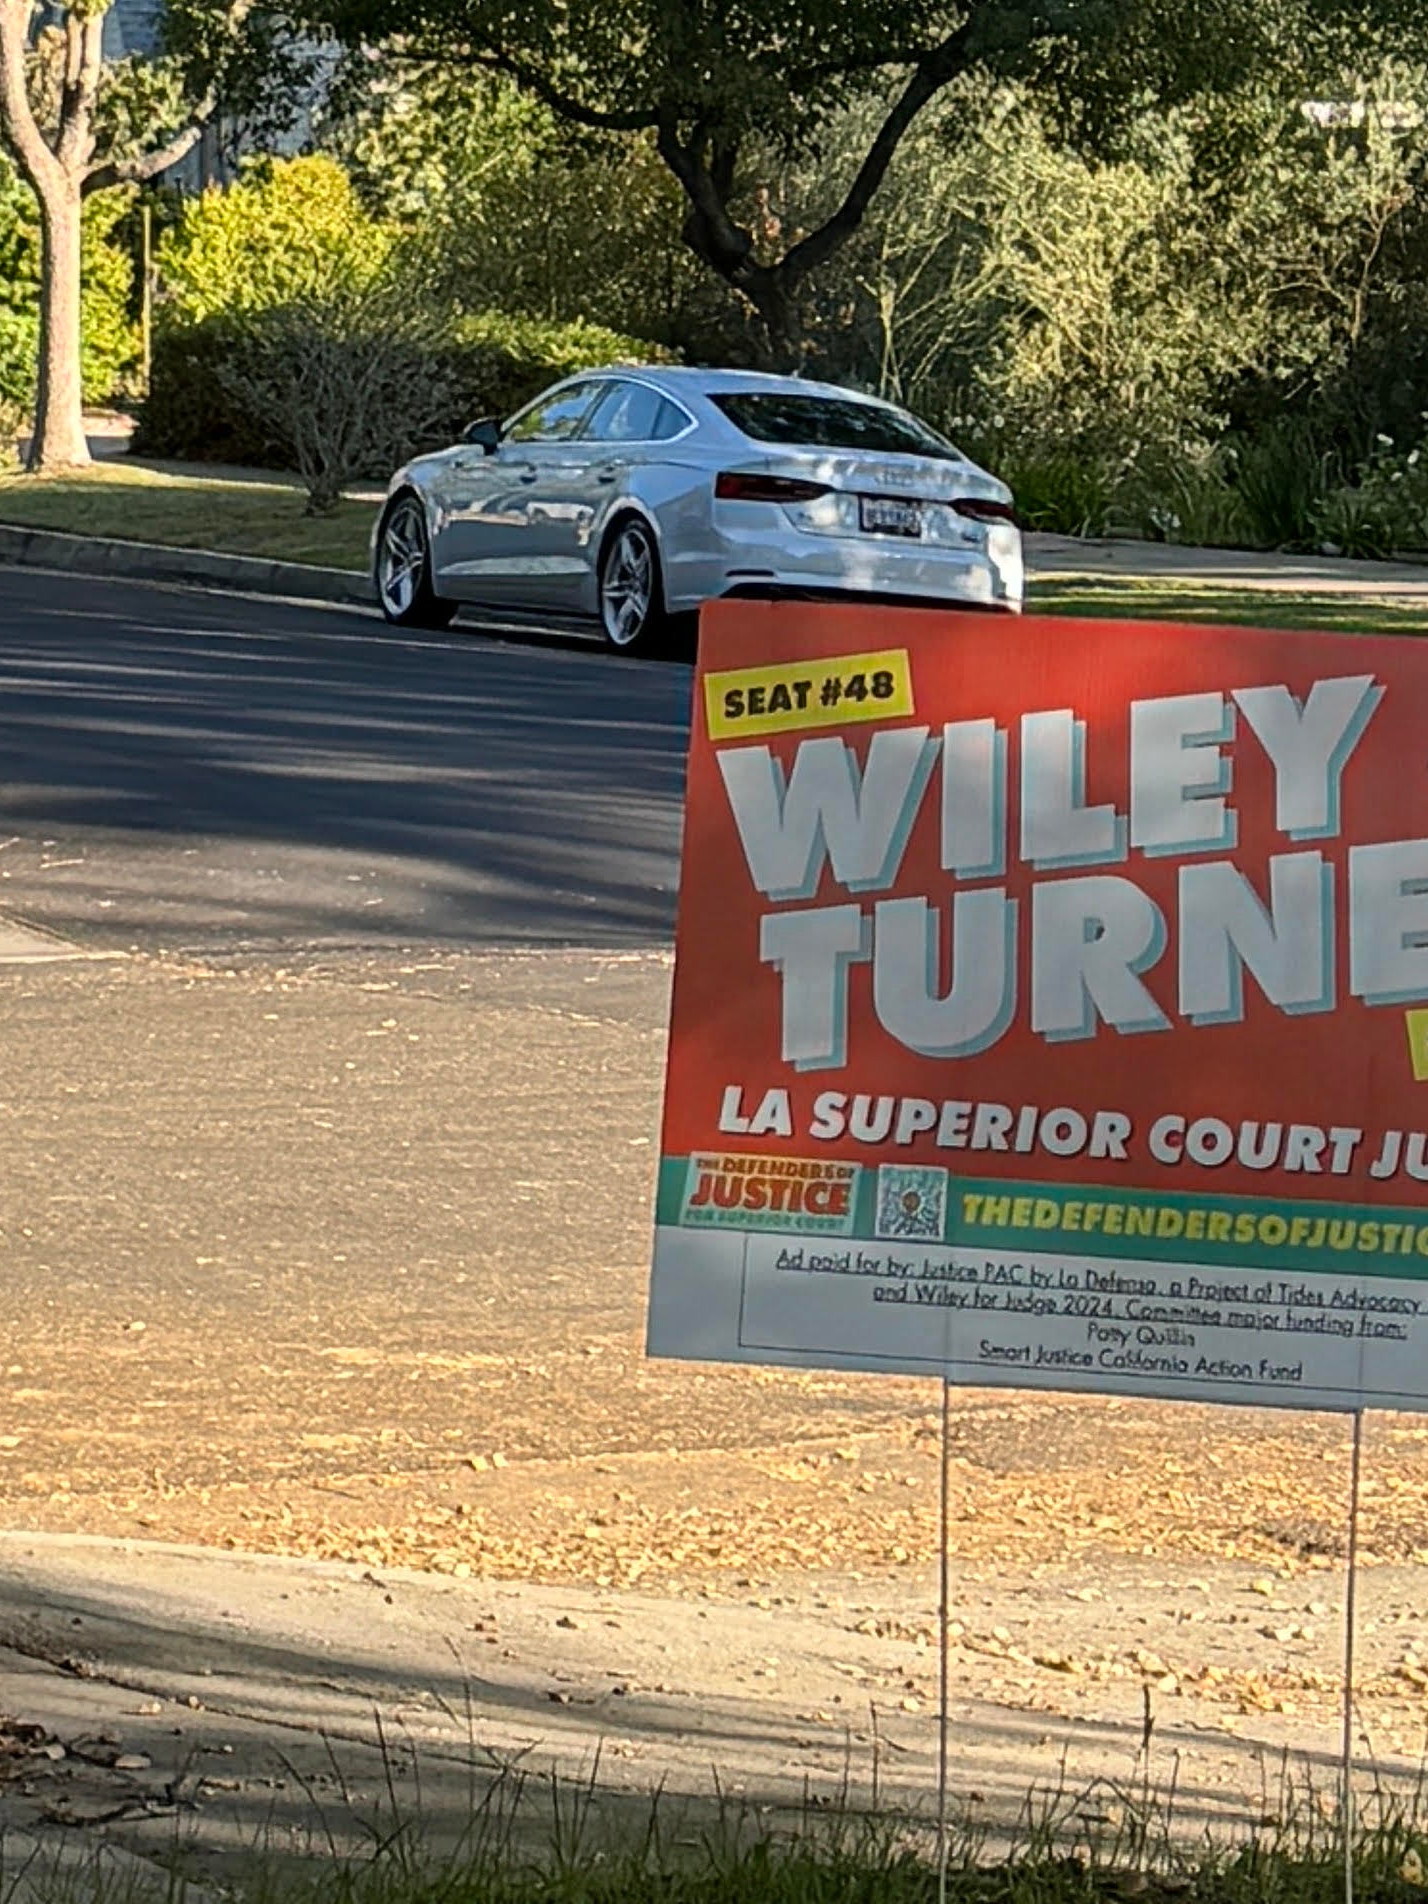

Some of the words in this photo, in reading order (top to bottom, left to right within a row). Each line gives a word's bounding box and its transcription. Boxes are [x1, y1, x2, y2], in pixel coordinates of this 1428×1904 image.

[724, 680, 812, 720] SEAT
[819, 670, 895, 708] #48
[715, 673, 1387, 903] WILEY
[718, 1085, 793, 1138] LA
[809, 1090, 1133, 1162] SUPERIOR
[1148, 1113, 1364, 1176] COURT
[723, 1156, 835, 1179] DEFENDERS
[689, 1173, 852, 1216] JUSTICE
[775, 1247, 804, 1270] Ad
[808, 1251, 851, 1274] paid
[856, 1251, 881, 1274] for
[922, 1258, 978, 1282] Justice
[984, 1261, 1023, 1284] PAC
[1030, 1265, 1054, 1289] by
[1188, 1275, 1250, 1302] Project
[1254, 1282, 1273, 1302] of
[1329, 1287, 1421, 1316] Advocacy
[873, 1281, 909, 1302] and
[915, 1282, 969, 1310] Wiley
[973, 1285, 998, 1309] for
[1005, 1288, 1057, 1315] Judge
[1124, 1298, 1222, 1326] Committee
[1227, 1309, 1280, 1331] major
[1285, 1307, 1355, 1338] funding
[979, 1338, 1031, 1361] Smart
[1035, 1343, 1094, 1366] Justice
[1099, 1347, 1189, 1372] California
[1194, 1356, 1253, 1379] Action
[1259, 1359, 1303, 1381] Fund
